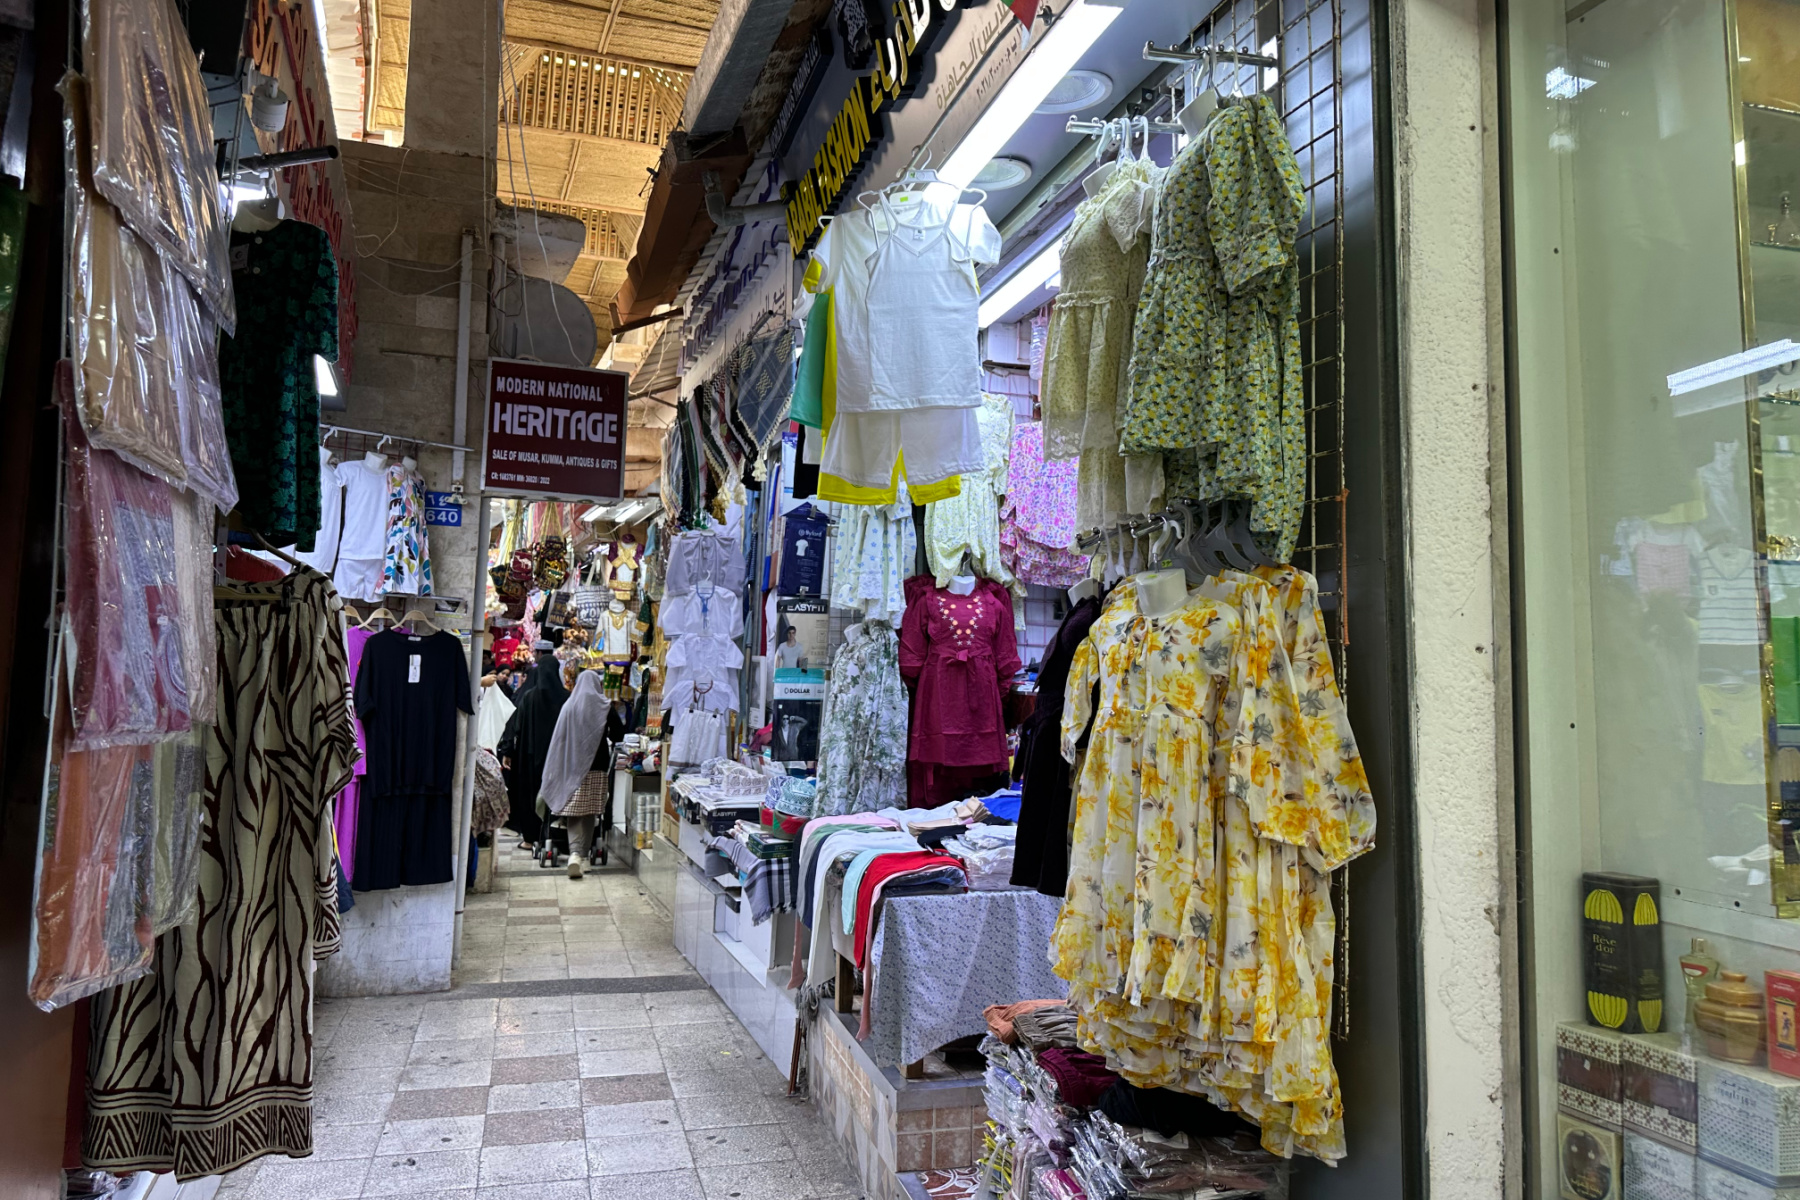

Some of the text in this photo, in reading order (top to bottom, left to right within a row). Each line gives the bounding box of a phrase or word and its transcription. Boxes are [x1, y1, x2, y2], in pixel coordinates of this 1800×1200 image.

[785, 76, 871, 261] ABABIL FASHION
[496, 376, 603, 403] MODERN NATIONAL
[493, 402, 618, 444] HERITAGE
[492, 449, 618, 470] SALE OF MUSAR, KUMMA, ANTIQUES & GIFTS
[426, 510, 459, 524] 640
[787, 603, 826, 613] EASYFIT
[789, 687, 811, 695] DOLLAR
